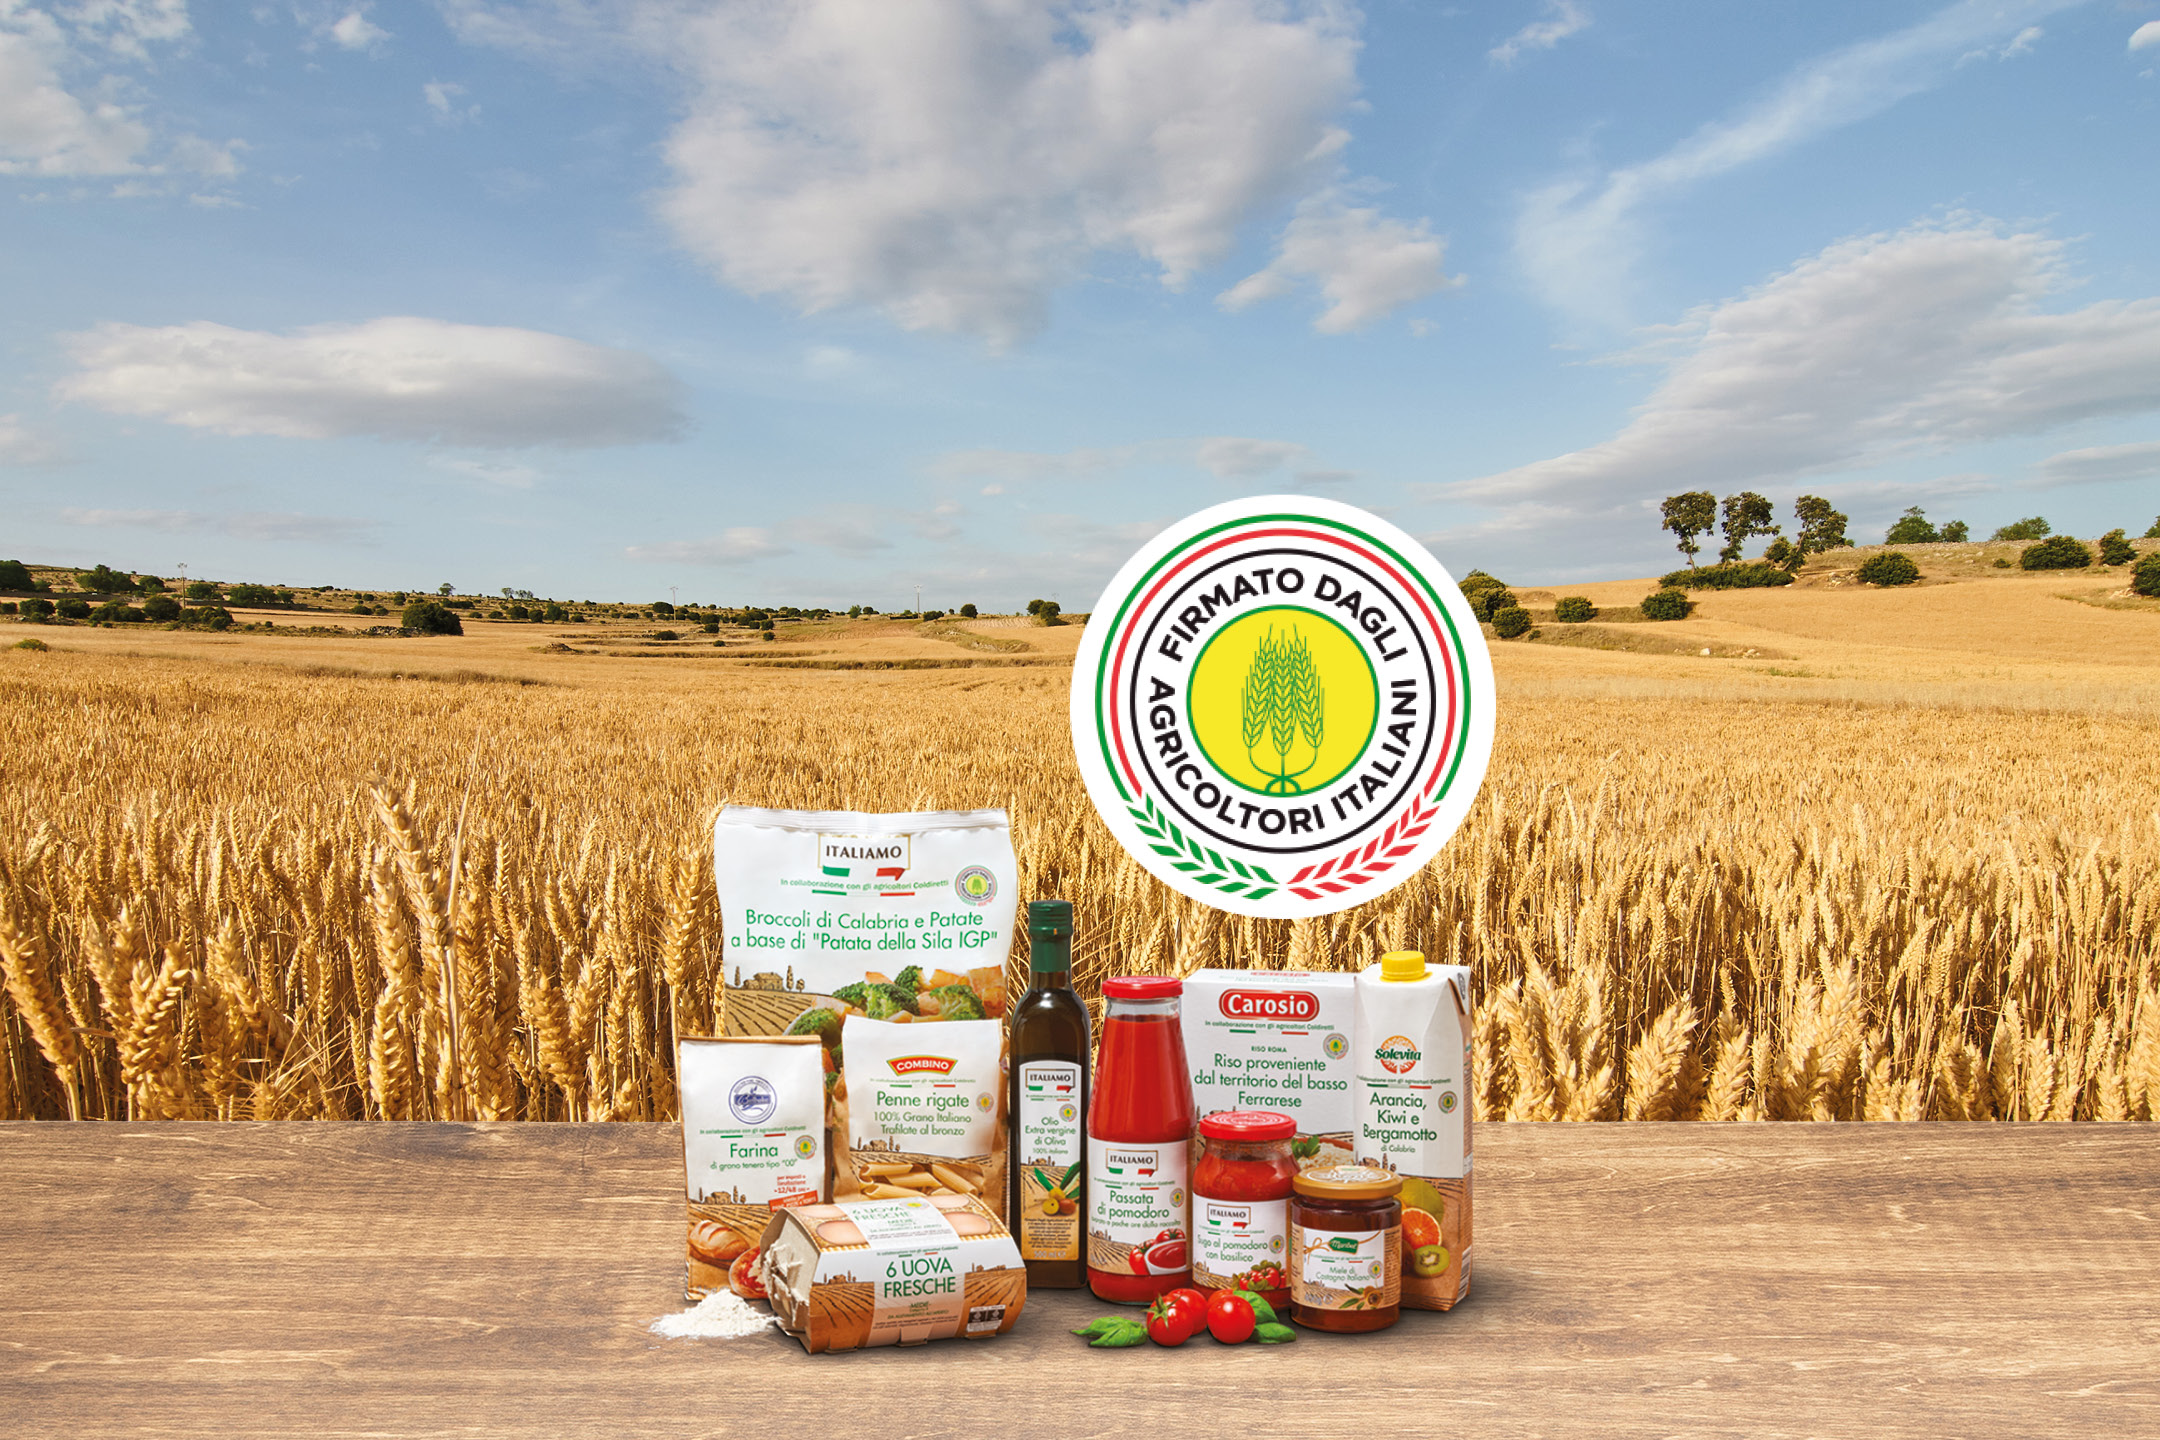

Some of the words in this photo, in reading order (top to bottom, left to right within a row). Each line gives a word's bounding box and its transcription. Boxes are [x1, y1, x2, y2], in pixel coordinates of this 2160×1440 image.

[825, 844, 903, 860] ITALIAMO
[789, 879, 844, 889] collaborazione
[846, 882, 861, 890] con
[873, 881, 912, 891] agricoltori
[913, 879, 949, 889] Coldiretti
[745, 908, 811, 928] Broccoli
[816, 910, 832, 928] di
[838, 912, 909, 930] Calabria
[914, 917, 924, 928] e
[930, 910, 983, 927] Patate
[731, 936, 741, 948] a
[746, 928, 785, 949] base
[790, 931, 806, 949] di
[813, 932, 872, 950] "Patata
[877, 931, 917, 950] della
[922, 930, 952, 949] Sila
[959, 930, 998, 949] IGP"
[1228, 994, 1309, 1015] Carosio
[1375, 1048, 1421, 1061] Solevita
[896, 1059, 949, 1071] COMBINO
[1214, 1053, 1242, 1068] Riso
[1246, 1057, 1326, 1072] proveniente
[1030, 1074, 1071, 1082] ITALIAMO
[1194, 1069, 1215, 1085] dal
[1220, 1073, 1278, 1089] territorio
[1282, 1074, 1302, 1089] del
[1307, 1074, 1348, 1091] basso
[877, 1091, 921, 1107] Penne
[926, 1092, 970, 1112] rigate
[1238, 1091, 1302, 1107] Ferrarese
[1370, 1092, 1427, 1110] Arancia,
[874, 1112, 900, 1122] 100%
[903, 1112, 935, 1123] Grano
[937, 1112, 972, 1124] Italiano
[1041, 1116, 1059, 1126] Olio
[1377, 1109, 1407, 1124] Kiwi
[1410, 1116, 1420, 1125] e
[881, 1124, 917, 1135] Trafilate
[920, 1124, 929, 1135] al
[932, 1124, 966, 1136] bronzo
[1025, 1125, 1045, 1135] Extra
[1047, 1126, 1076, 1136] vergine
[1363, 1124, 1437, 1144] Bergamotto
[1034, 1136, 1042, 1146] di
[1044, 1136, 1066, 1146] Oliva
[730, 1143, 778, 1158] Farina
[710, 1162, 718, 1170] di
[719, 1162, 741, 1171] grano
[742, 1161, 765, 1169] tenero
[766, 1160, 780, 1170] tipo
[1110, 1155, 1153, 1165] ITALIAMO
[1110, 1190, 1153, 1205] Passata
[1097, 1201, 1106, 1215] di
[1109, 1205, 1170, 1220] pomodoro
[1210, 1209, 1247, 1219] ITALIAMO
[1213, 1238, 1221, 1248] al
[1222, 1240, 1268, 1251] pomodoro
[1205, 1251, 1219, 1259] con
[1220, 1250, 1253, 1262] basilico
[886, 1261, 897, 1278] 6
[902, 1257, 953, 1277] UOVA
[884, 1276, 956, 1298] FRESCHE
